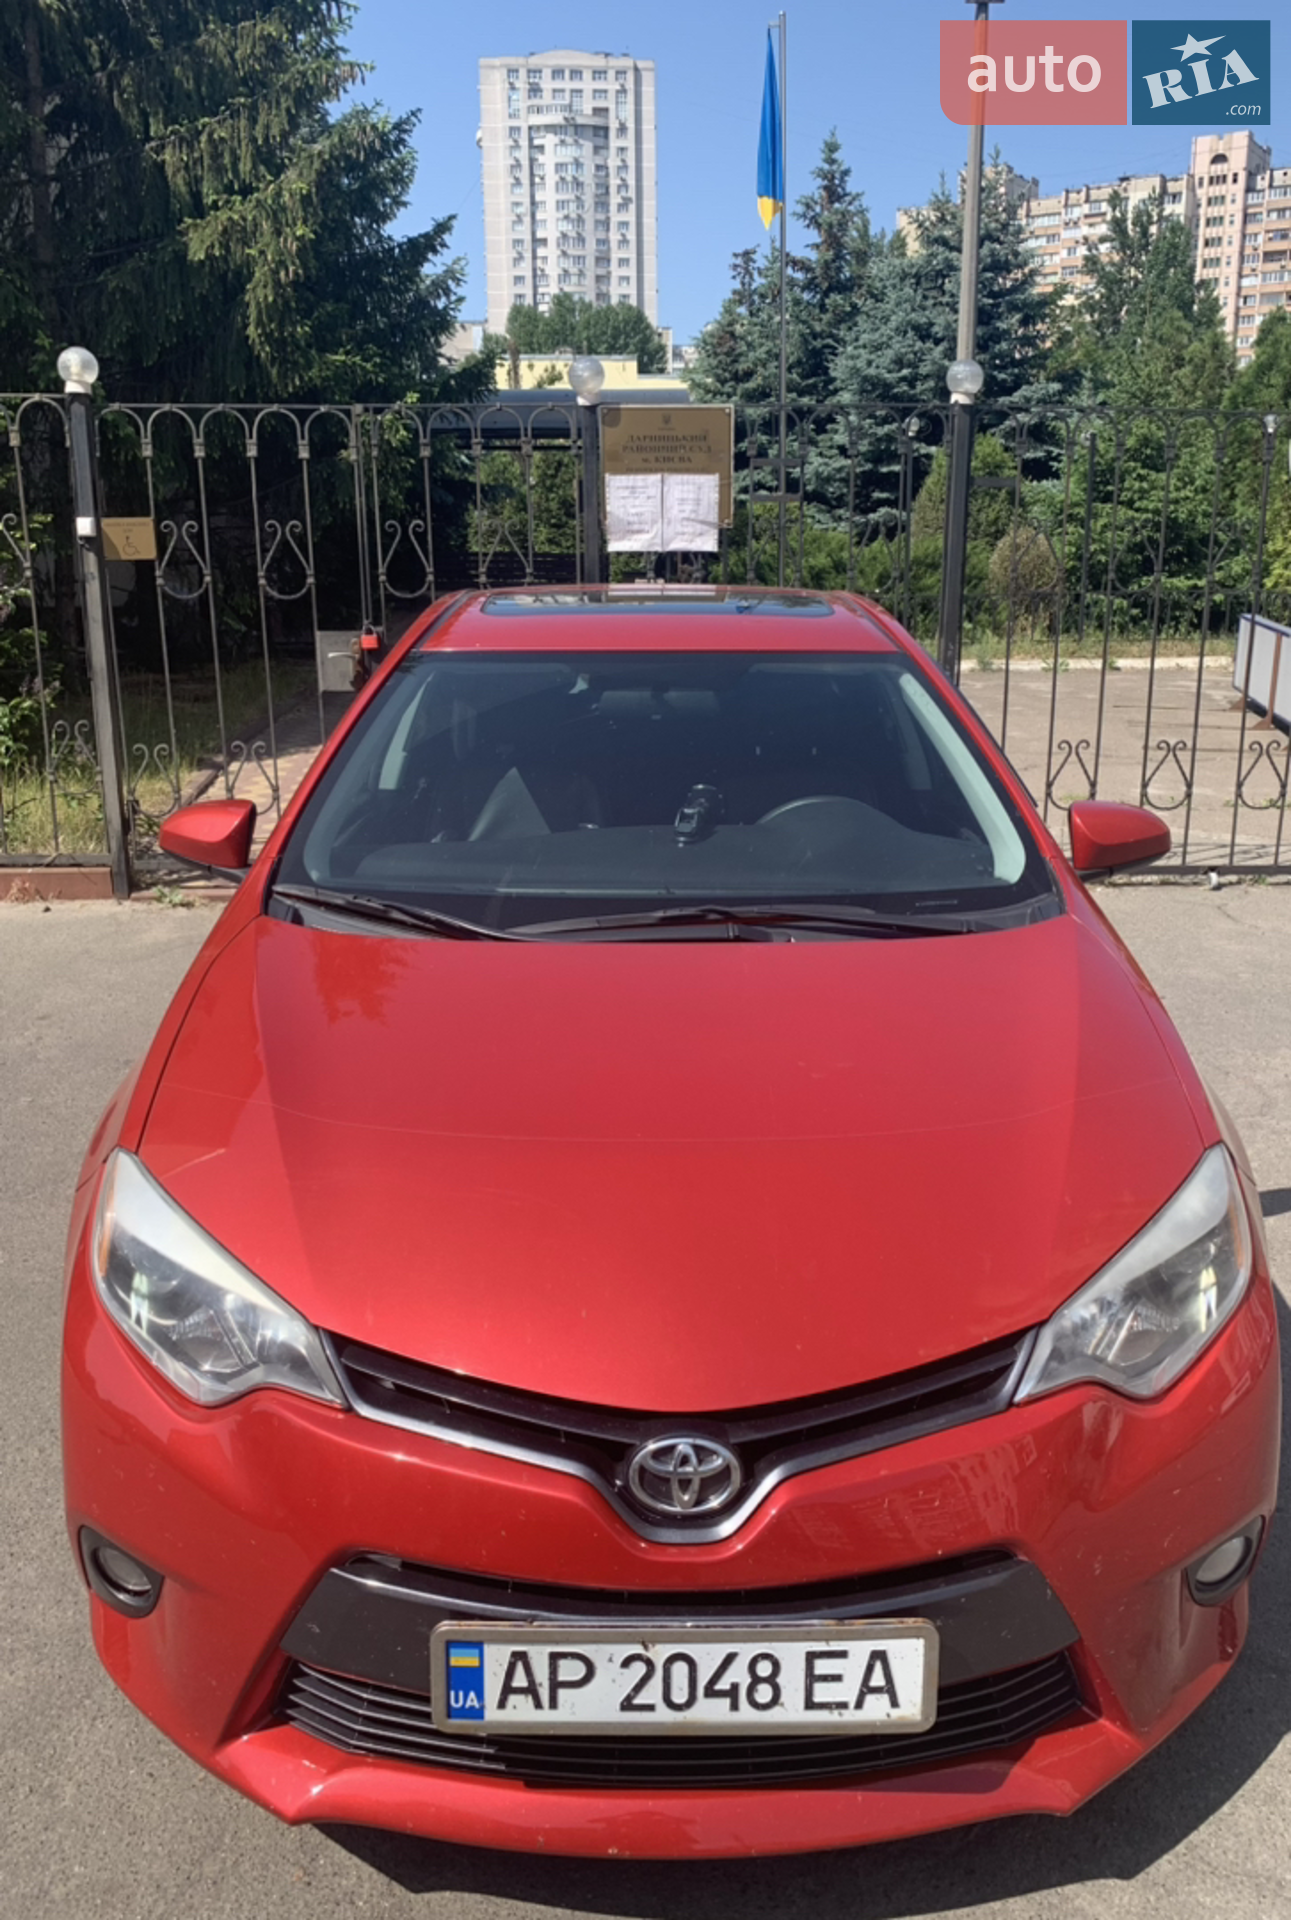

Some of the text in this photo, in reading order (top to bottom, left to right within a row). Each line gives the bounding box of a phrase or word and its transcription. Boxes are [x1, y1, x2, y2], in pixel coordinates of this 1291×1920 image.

[450, 1691, 479, 1709] UA
[496, 1649, 900, 1712] AP 2048 EA
